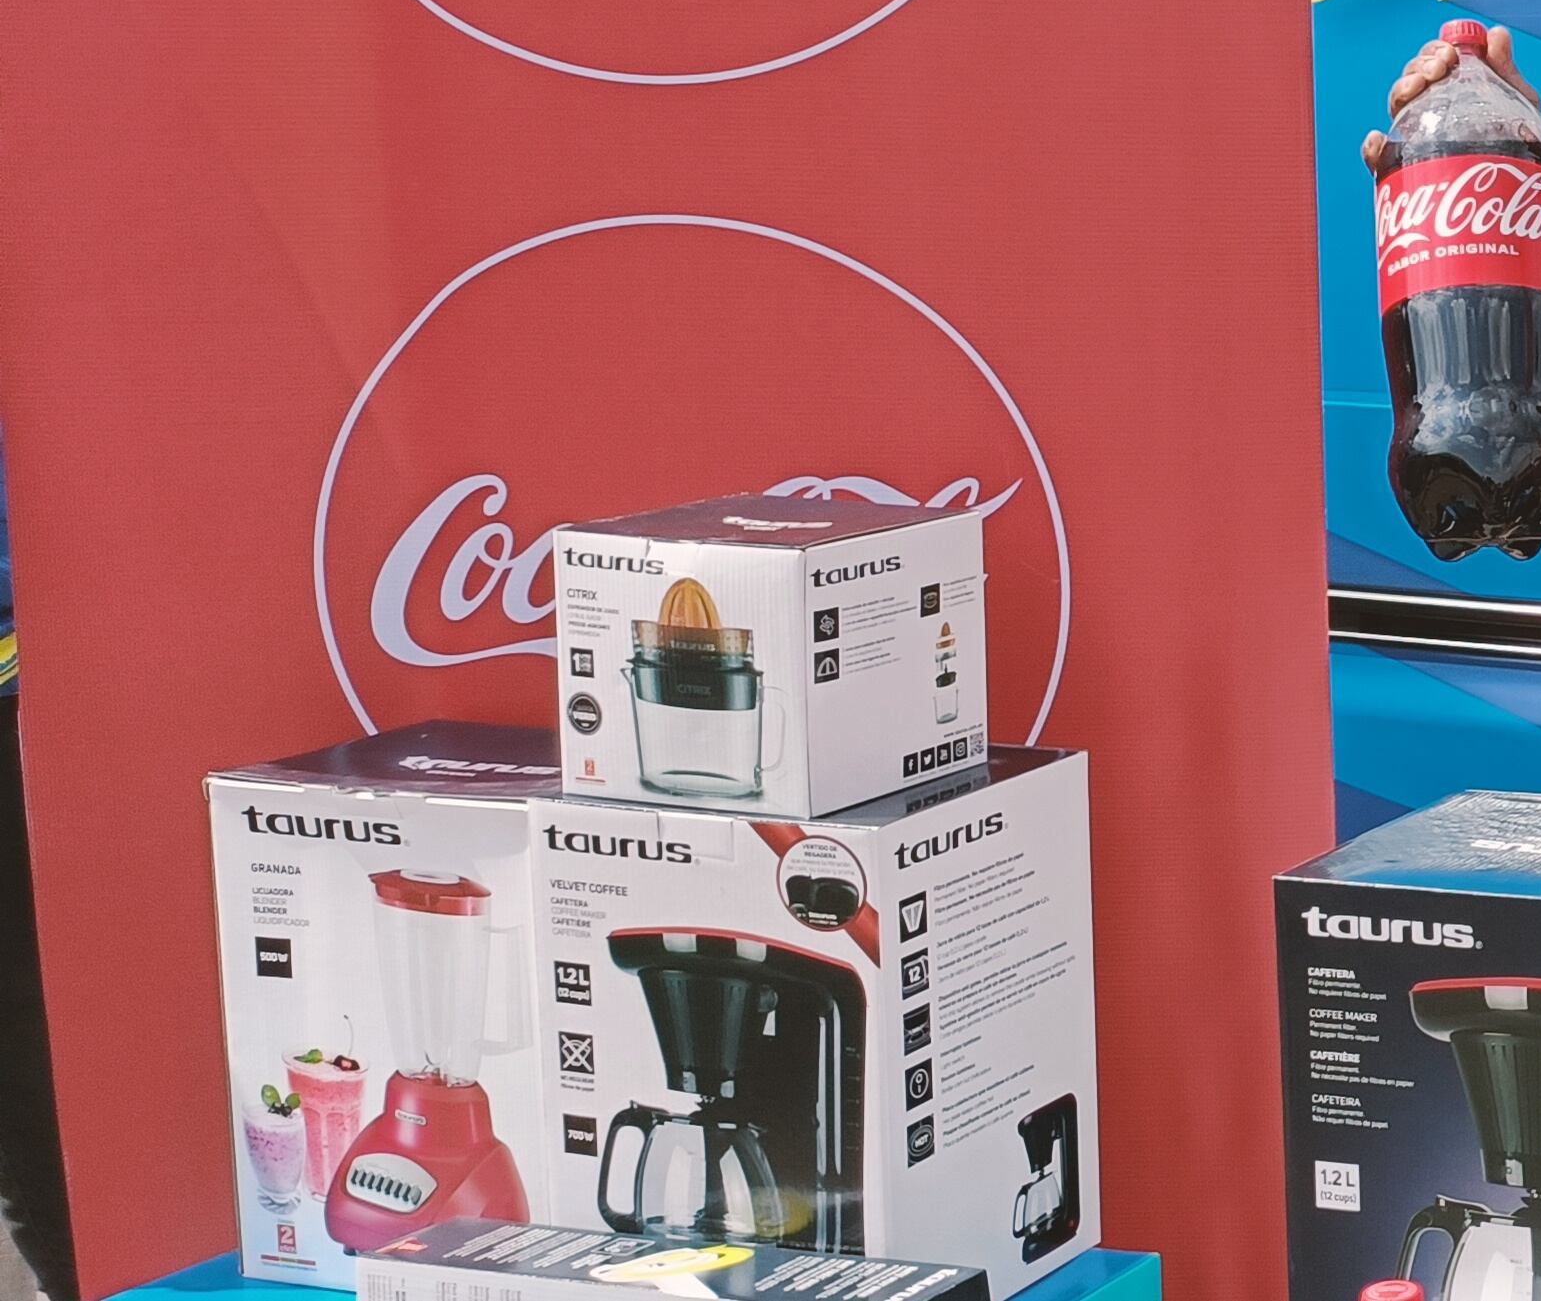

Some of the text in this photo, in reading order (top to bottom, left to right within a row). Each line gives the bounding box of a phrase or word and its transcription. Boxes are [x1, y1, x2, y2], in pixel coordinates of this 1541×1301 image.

[1387, 243, 1520, 277] SABOR ORIGINAL
[563, 547, 665, 576] taurus
[810, 555, 901, 588] taurus
[567, 588, 597, 600] CITRIX
[241, 805, 401, 846] taurus
[542, 824, 692, 863] taurus
[894, 812, 1003, 870] taurus
[251, 862, 302, 876] GRANADA
[550, 879, 628, 897] VELVET COFFEE
[1301, 906, 1474, 948] taurus
[1308, 967, 1355, 979] CAFETERA
[1309, 1008, 1378, 1022] COFFEE MAKER
[1312, 1094, 1361, 1107] CAFETEIRA
[1320, 1169, 1355, 1187] 1.2 L
